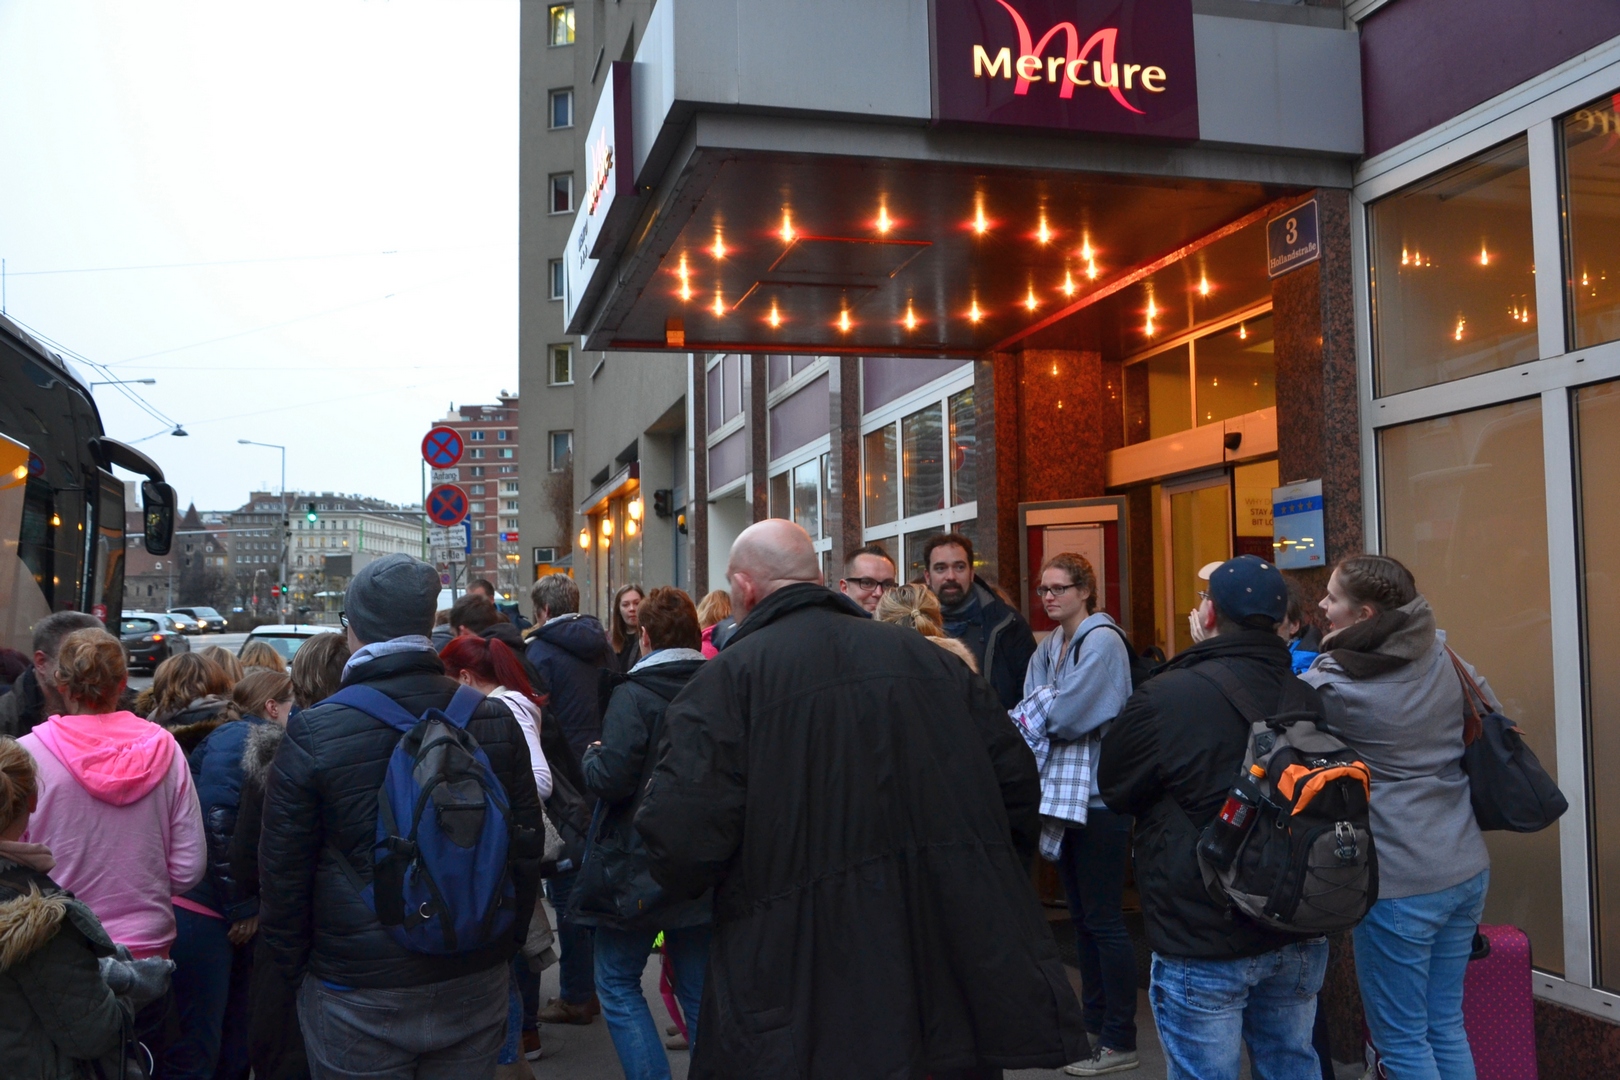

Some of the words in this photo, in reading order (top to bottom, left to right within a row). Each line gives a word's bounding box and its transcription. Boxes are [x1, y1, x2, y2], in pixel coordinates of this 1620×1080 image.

[973, 44, 1167, 93] Mercure
[1286, 217, 1298, 245] 3
[1270, 242, 1317, 269] Hollandstraße
[1250, 508, 1268, 516] STAY
[1252, 518, 1263, 526] BIT
